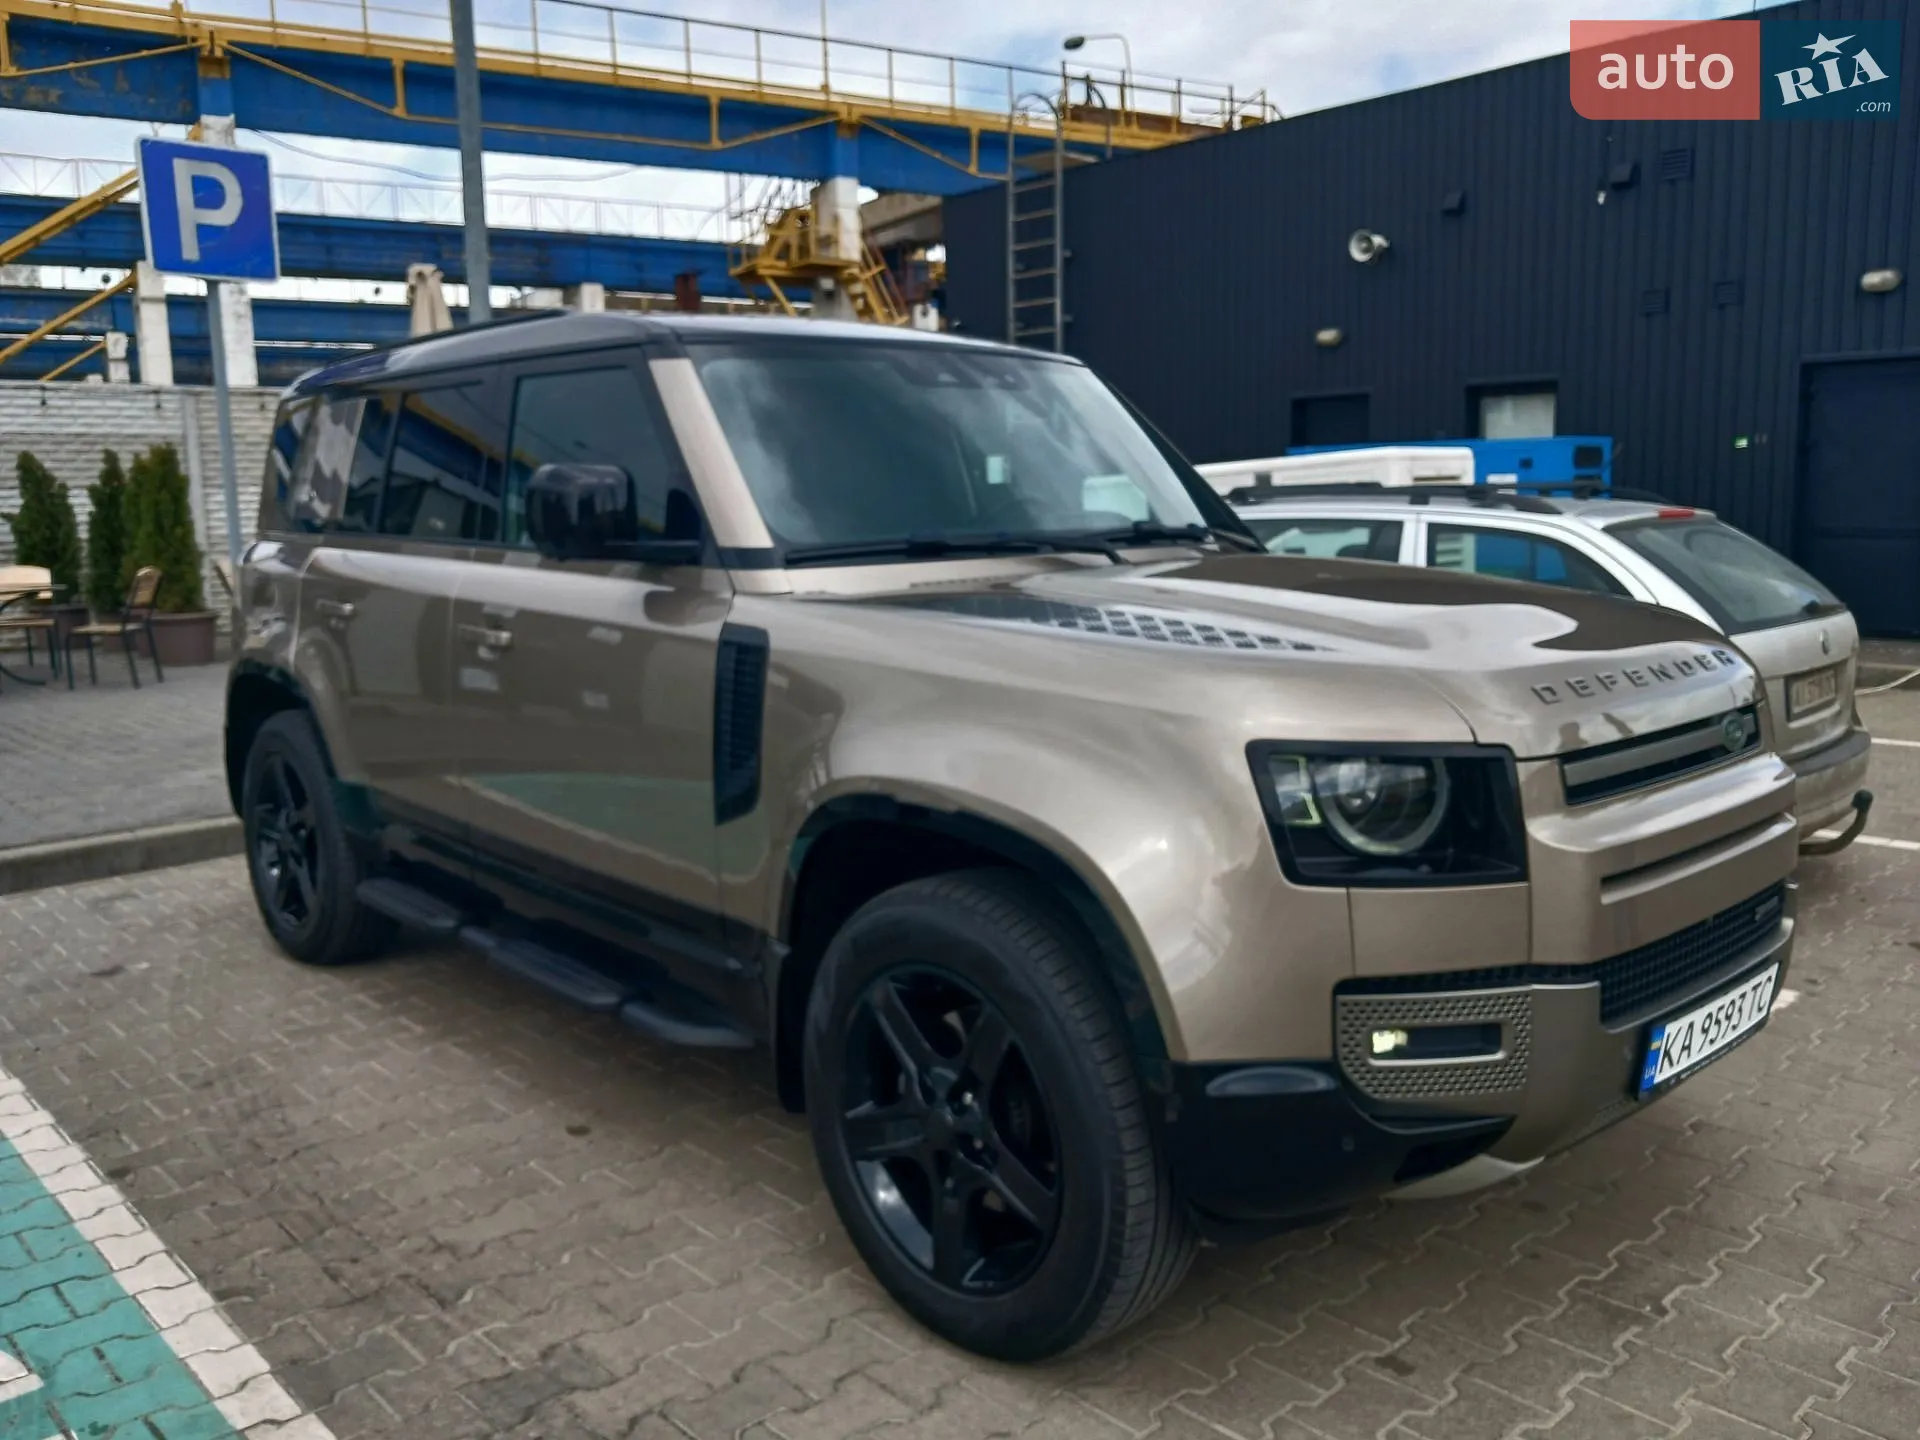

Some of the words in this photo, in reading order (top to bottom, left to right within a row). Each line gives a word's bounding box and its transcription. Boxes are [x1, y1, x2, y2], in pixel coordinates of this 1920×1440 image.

[172, 157, 243, 261] P
[1530, 649, 1734, 705] DEFENDER
[1658, 1019, 1695, 1074] KA
[1698, 990, 1746, 1052] 9593
[1748, 975, 1772, 1021] TC
